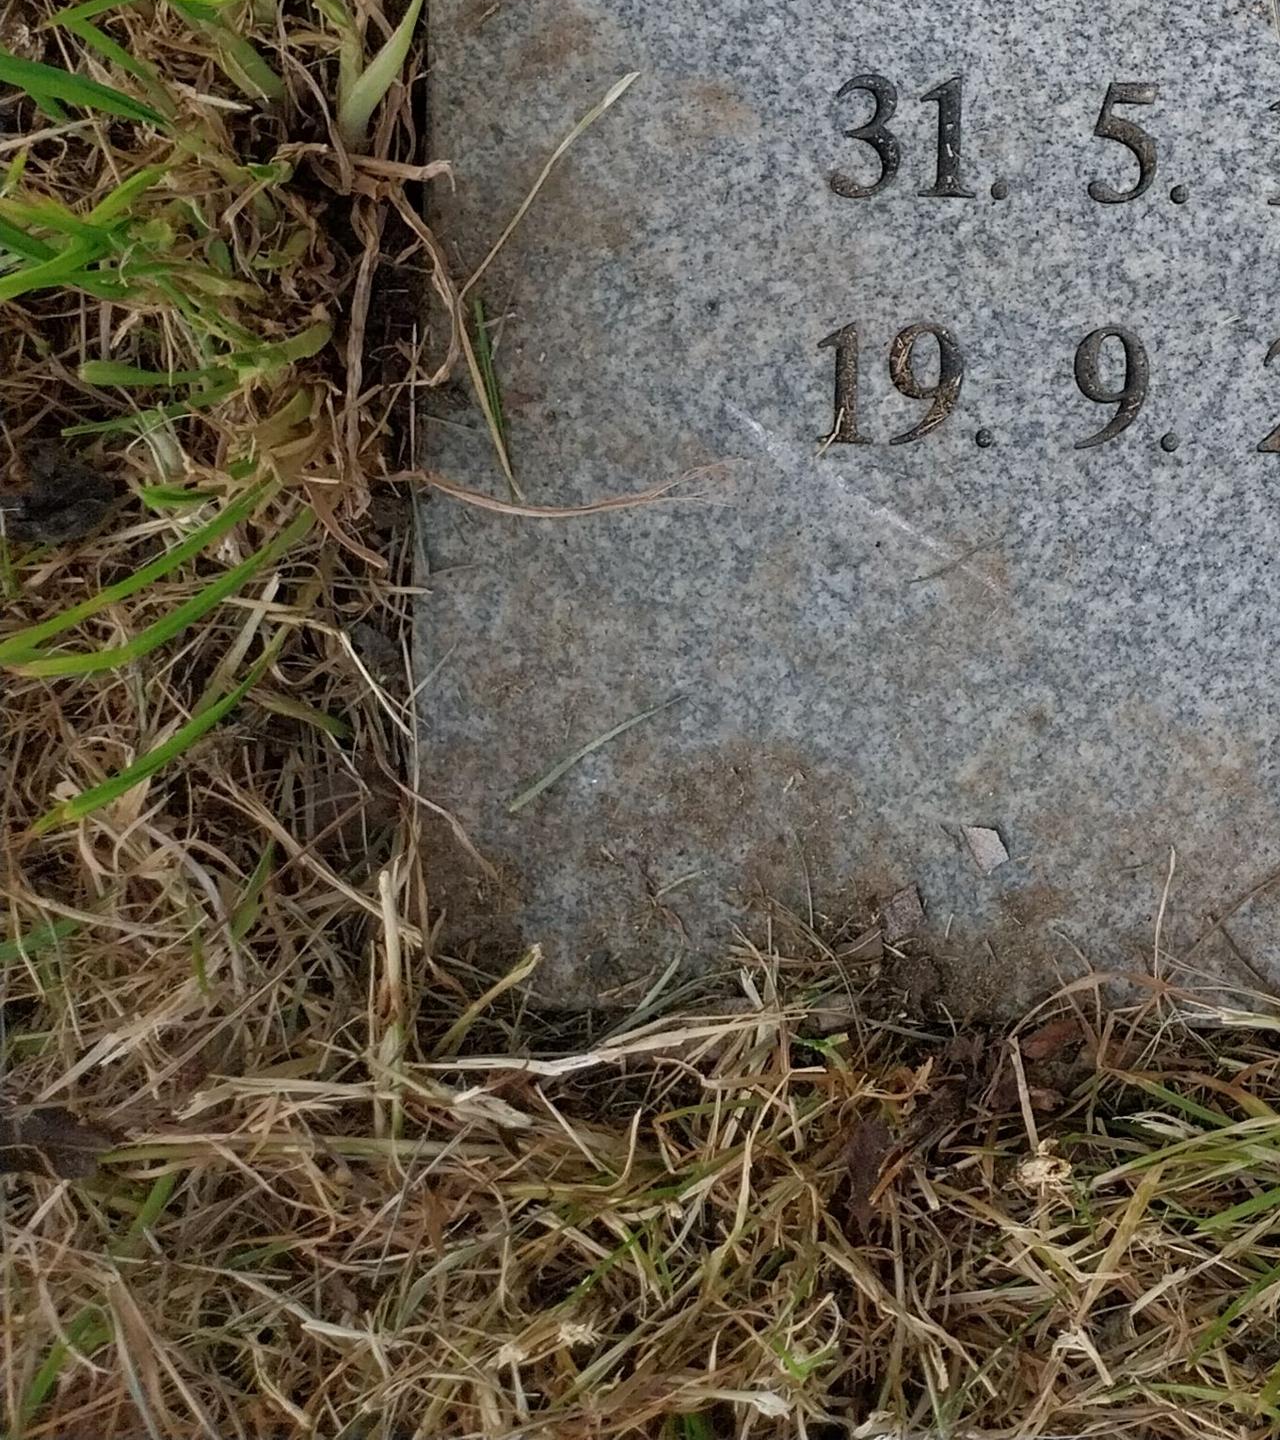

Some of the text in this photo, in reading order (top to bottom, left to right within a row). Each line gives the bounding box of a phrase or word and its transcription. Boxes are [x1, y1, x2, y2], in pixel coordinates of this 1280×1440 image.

[828, 72, 1008, 202] 31.
[1087, 81, 1192, 206] 5.
[814, 322, 995, 450] 19.
[1073, 325, 1181, 453] 9.
